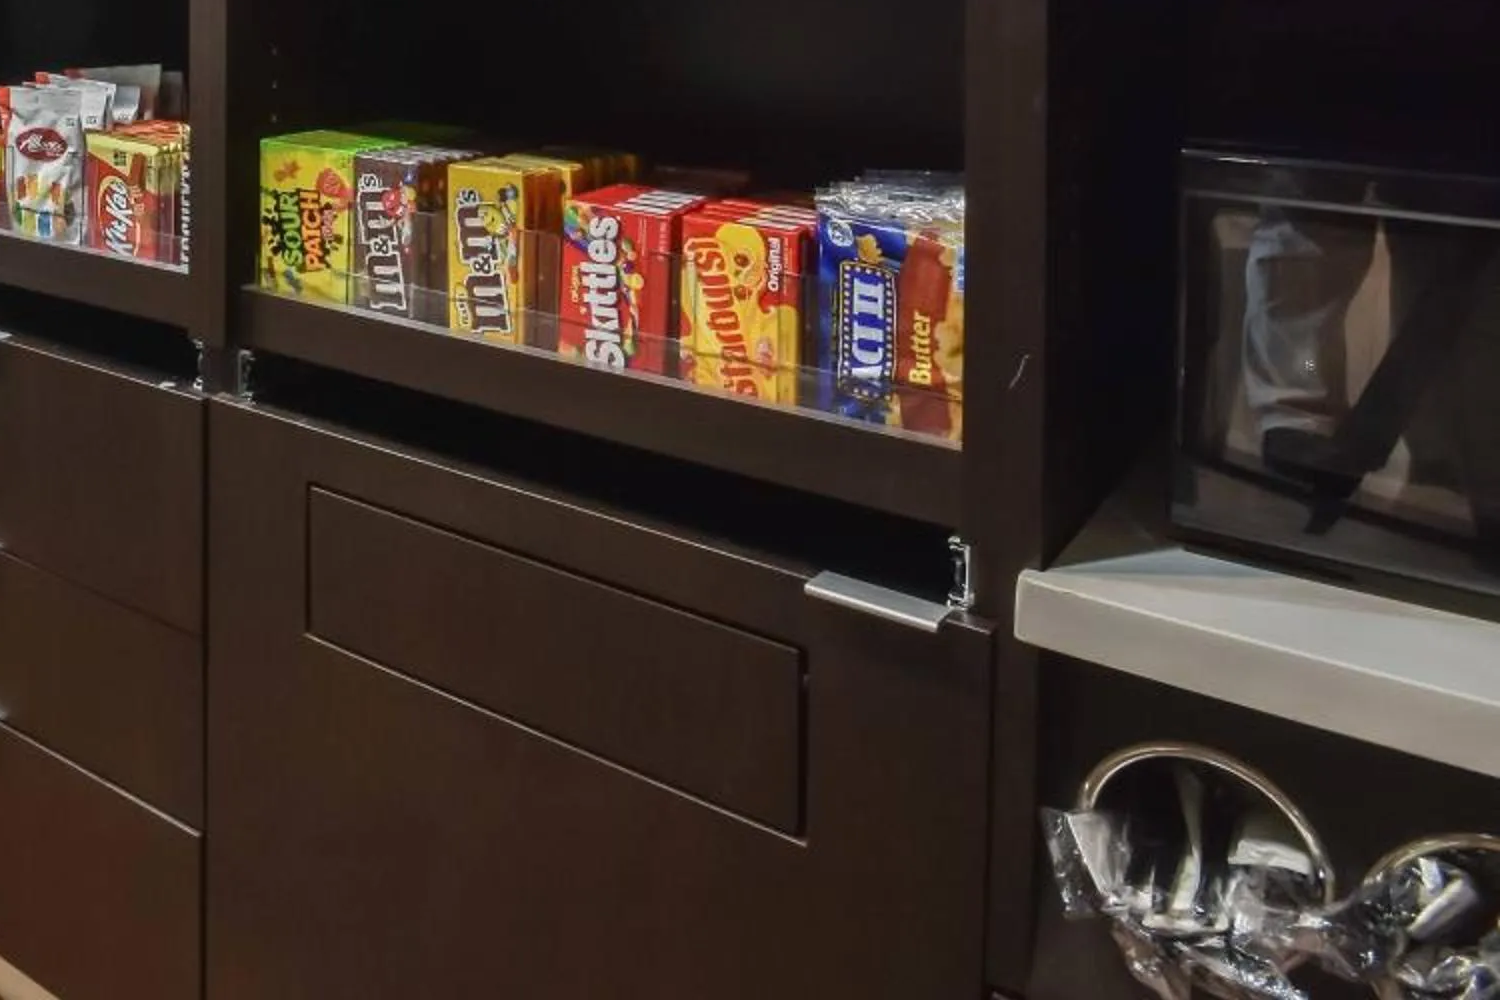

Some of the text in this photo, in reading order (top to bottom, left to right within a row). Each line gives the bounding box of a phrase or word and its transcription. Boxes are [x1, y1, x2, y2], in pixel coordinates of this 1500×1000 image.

[280, 193, 302, 267] SOUR
[300, 190, 324, 271] PATCH
[767, 237, 782, 292] Original
[580, 216, 626, 371] Skittles
[908, 309, 932, 386] Butter
